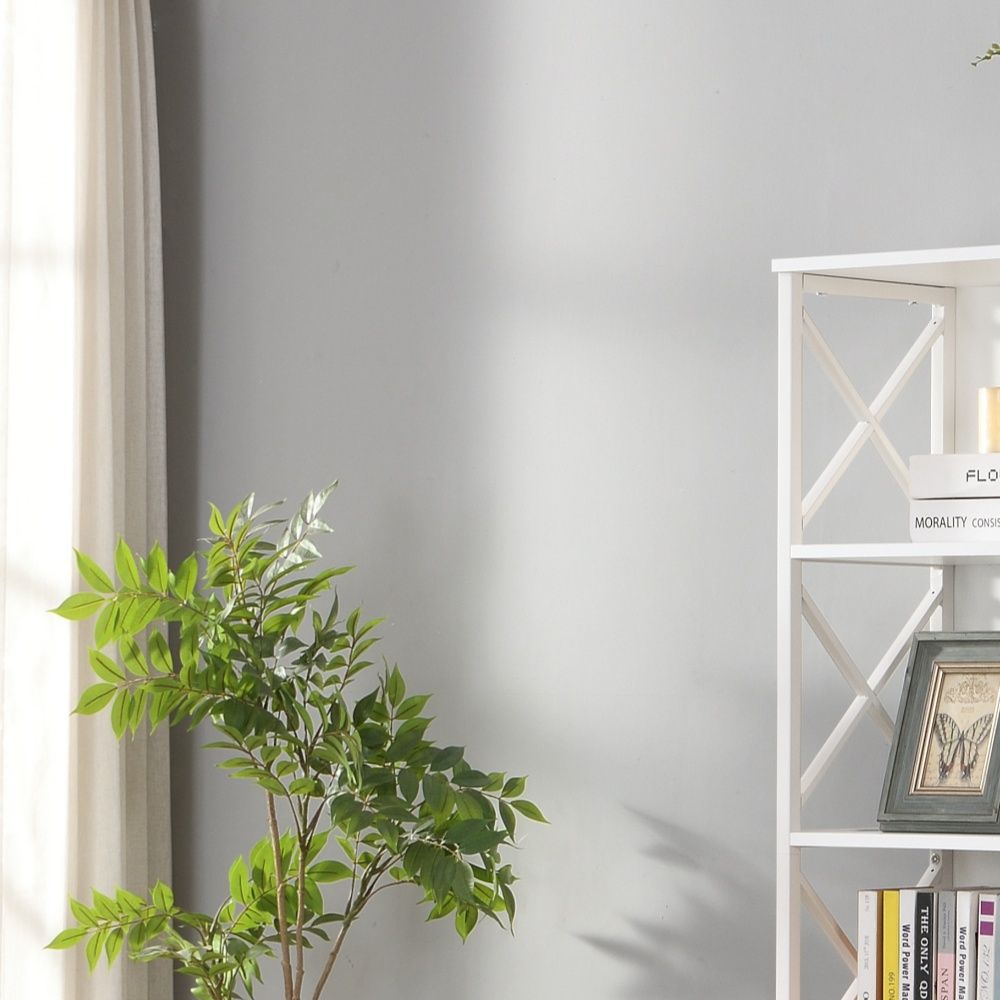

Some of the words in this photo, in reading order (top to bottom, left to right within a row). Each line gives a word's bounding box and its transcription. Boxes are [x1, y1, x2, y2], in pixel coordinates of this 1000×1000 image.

[915, 516, 967, 528] MORALITY
[920, 906, 929, 934] THE
[902, 924, 911, 948] Word
[959, 926, 967, 950] Word
[902, 951, 911, 980] Power
[920, 937, 929, 975] ONLY
[958, 953, 967, 982] Power
[919, 980, 929, 999] QD
